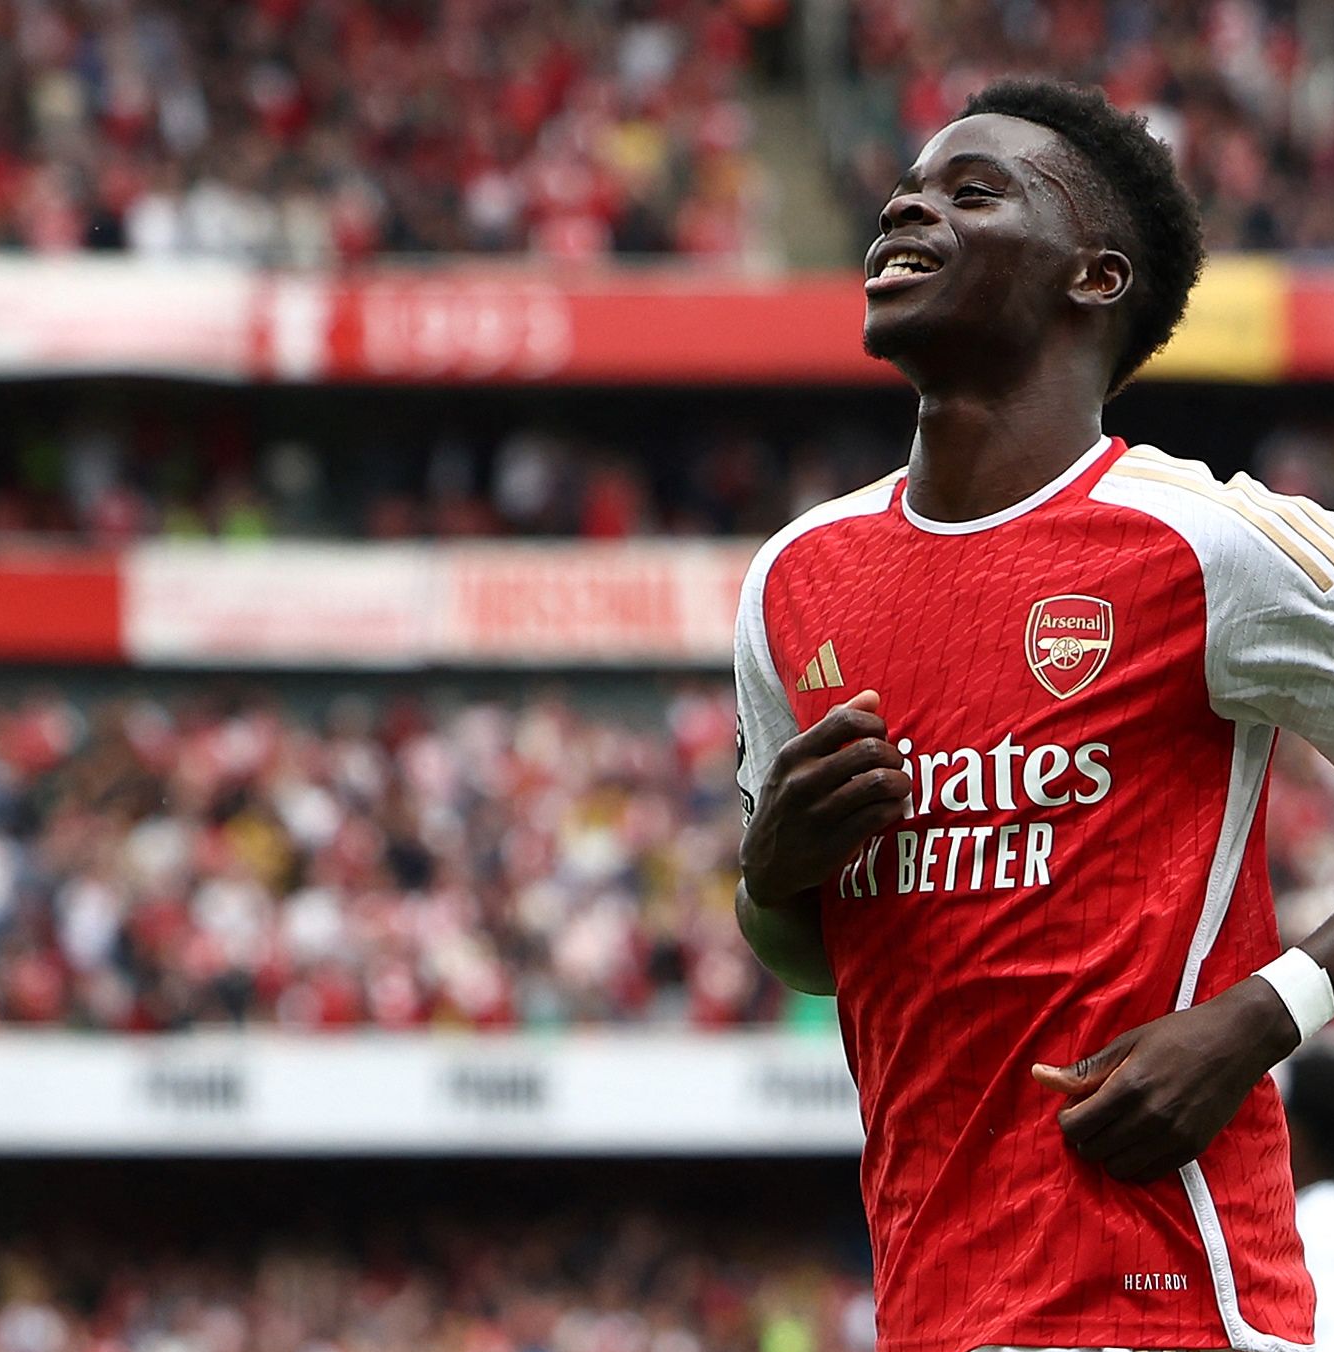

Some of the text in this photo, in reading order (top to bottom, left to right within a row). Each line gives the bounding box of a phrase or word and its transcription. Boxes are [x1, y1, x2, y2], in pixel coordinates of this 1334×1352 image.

[1039, 613, 1101, 630] Arsenal
[896, 732, 1112, 820] irates
[839, 822, 1053, 898] LY BETTER
[1124, 1273, 1187, 1290] HEAT.RDY
